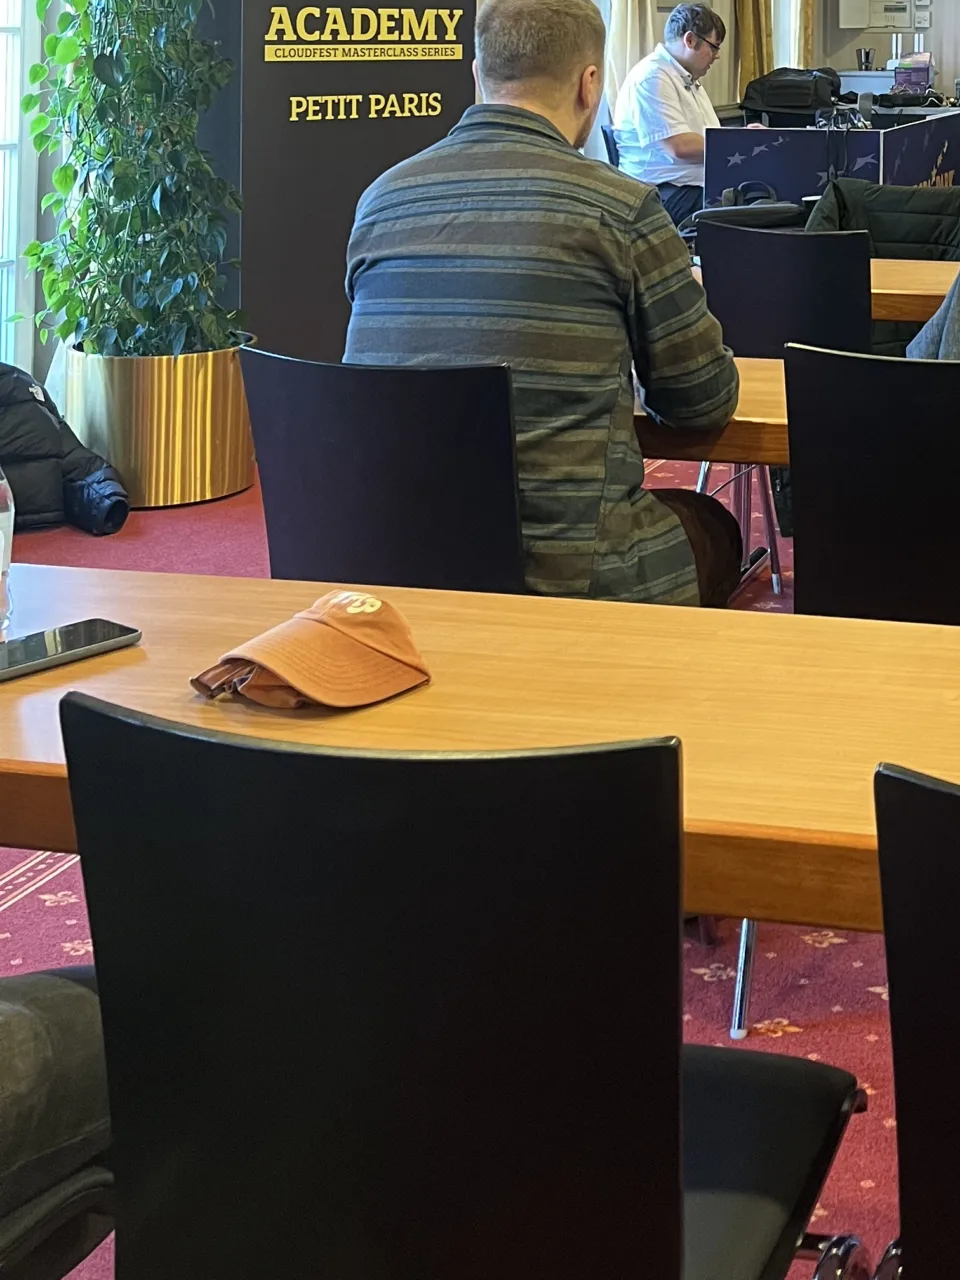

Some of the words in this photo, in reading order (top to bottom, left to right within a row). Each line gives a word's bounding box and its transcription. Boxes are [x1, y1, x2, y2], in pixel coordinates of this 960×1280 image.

[264, 6, 463, 41] ACADEMY
[274, 48, 339, 58] CLOUDFEST
[341, 47, 419, 57] MASTERCLASS
[421, 47, 456, 57] SERIES
[289, 95, 363, 122] PETIT
[368, 92, 442, 119] PARIS
